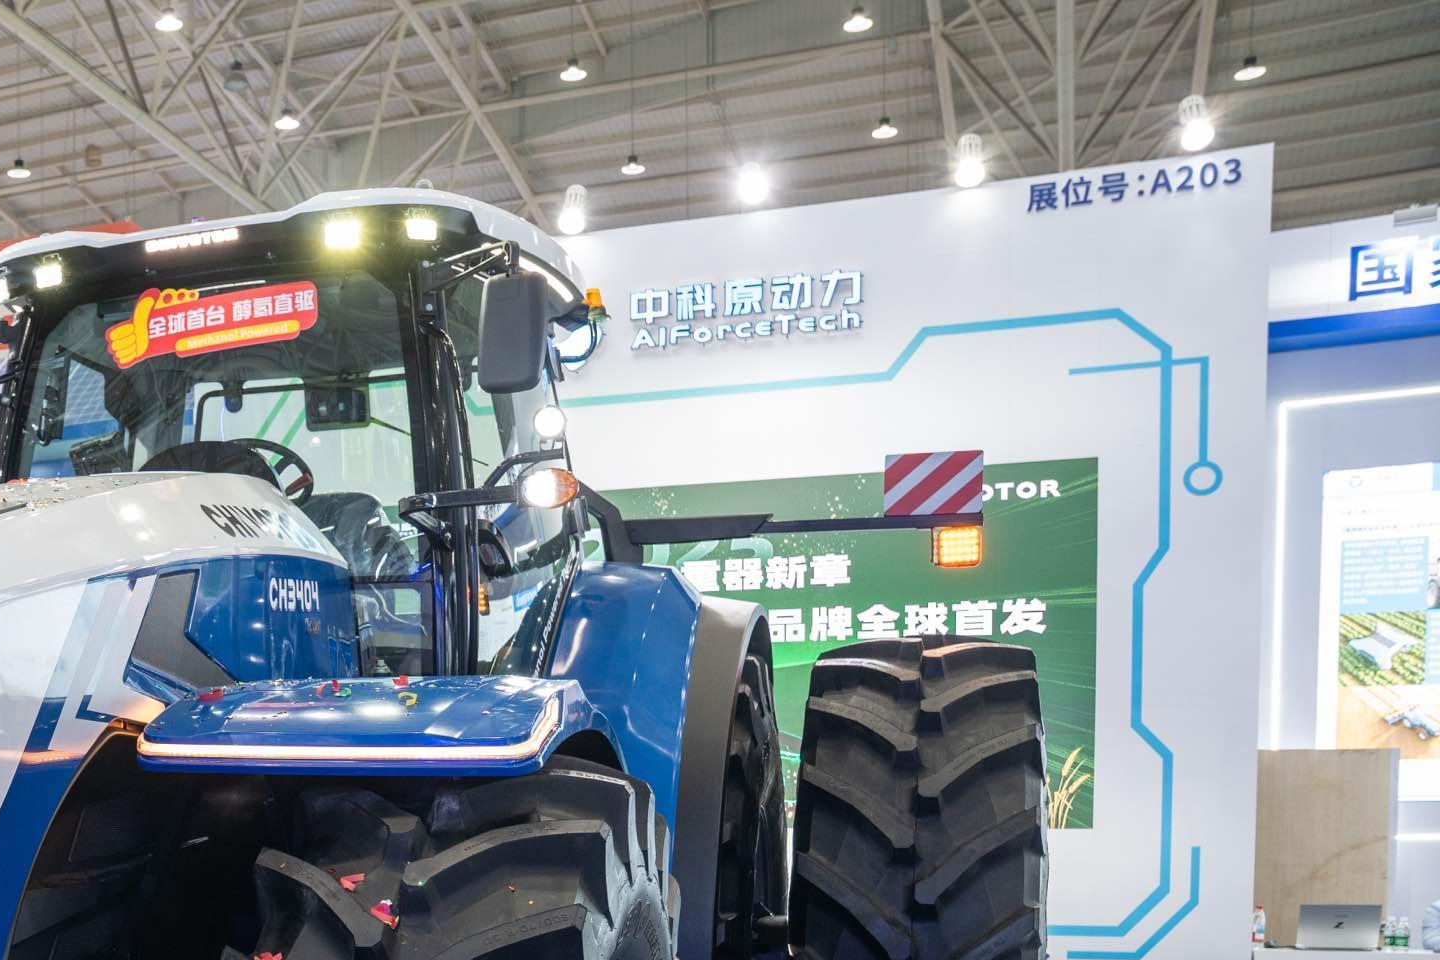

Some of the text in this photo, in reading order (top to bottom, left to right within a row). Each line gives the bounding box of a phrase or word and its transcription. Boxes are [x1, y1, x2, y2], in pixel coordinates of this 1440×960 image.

[1027, 157, 1243, 213] 展位号:A203
[1348, 241, 1440, 301] 国
[149, 289, 315, 340] 全球首台 醇氢直驱
[630, 269, 864, 325] 中科原动力
[269, 577, 321, 612] CH3404
[681, 553, 851, 592] 重器新章
[768, 598, 1047, 643] 品牌全球首发
